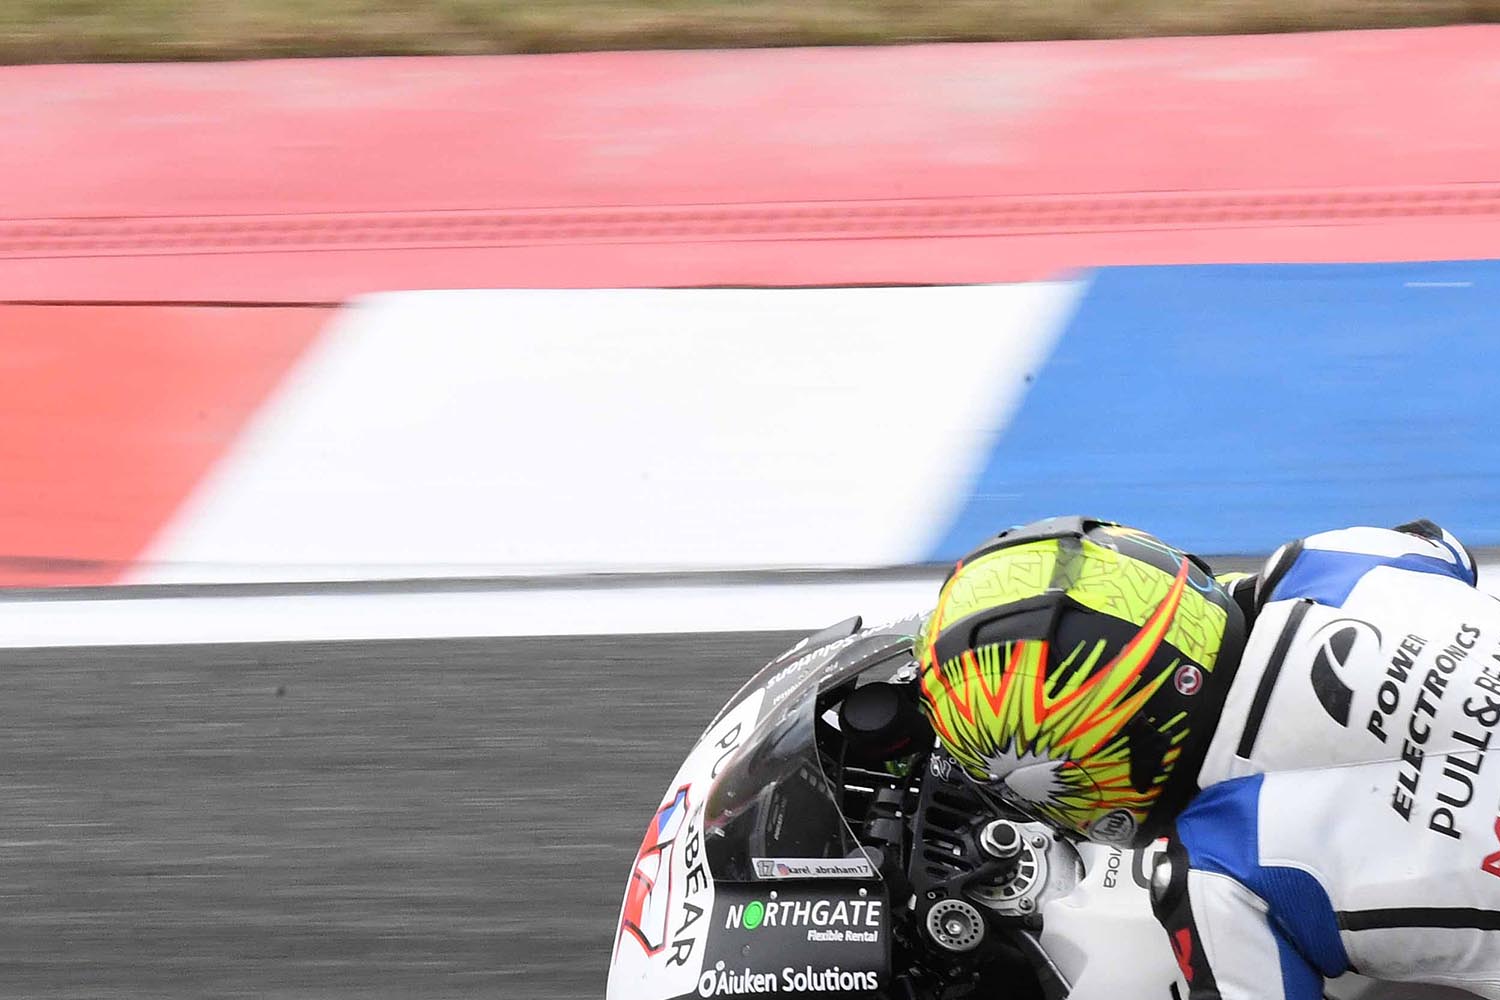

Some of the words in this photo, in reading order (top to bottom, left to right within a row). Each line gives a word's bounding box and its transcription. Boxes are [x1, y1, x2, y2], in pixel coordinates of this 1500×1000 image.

[1366, 632, 1429, 744] POWER
[1391, 622, 1481, 823] ELECTRONICS
[1102, 847, 1122, 888] iota
[725, 899, 882, 930] NORTHGATE
[807, 929, 844, 942] Flexible
[845, 930, 878, 942] Rental
[714, 966, 778, 995] Aiuken
[781, 965, 879, 993] Solutions
